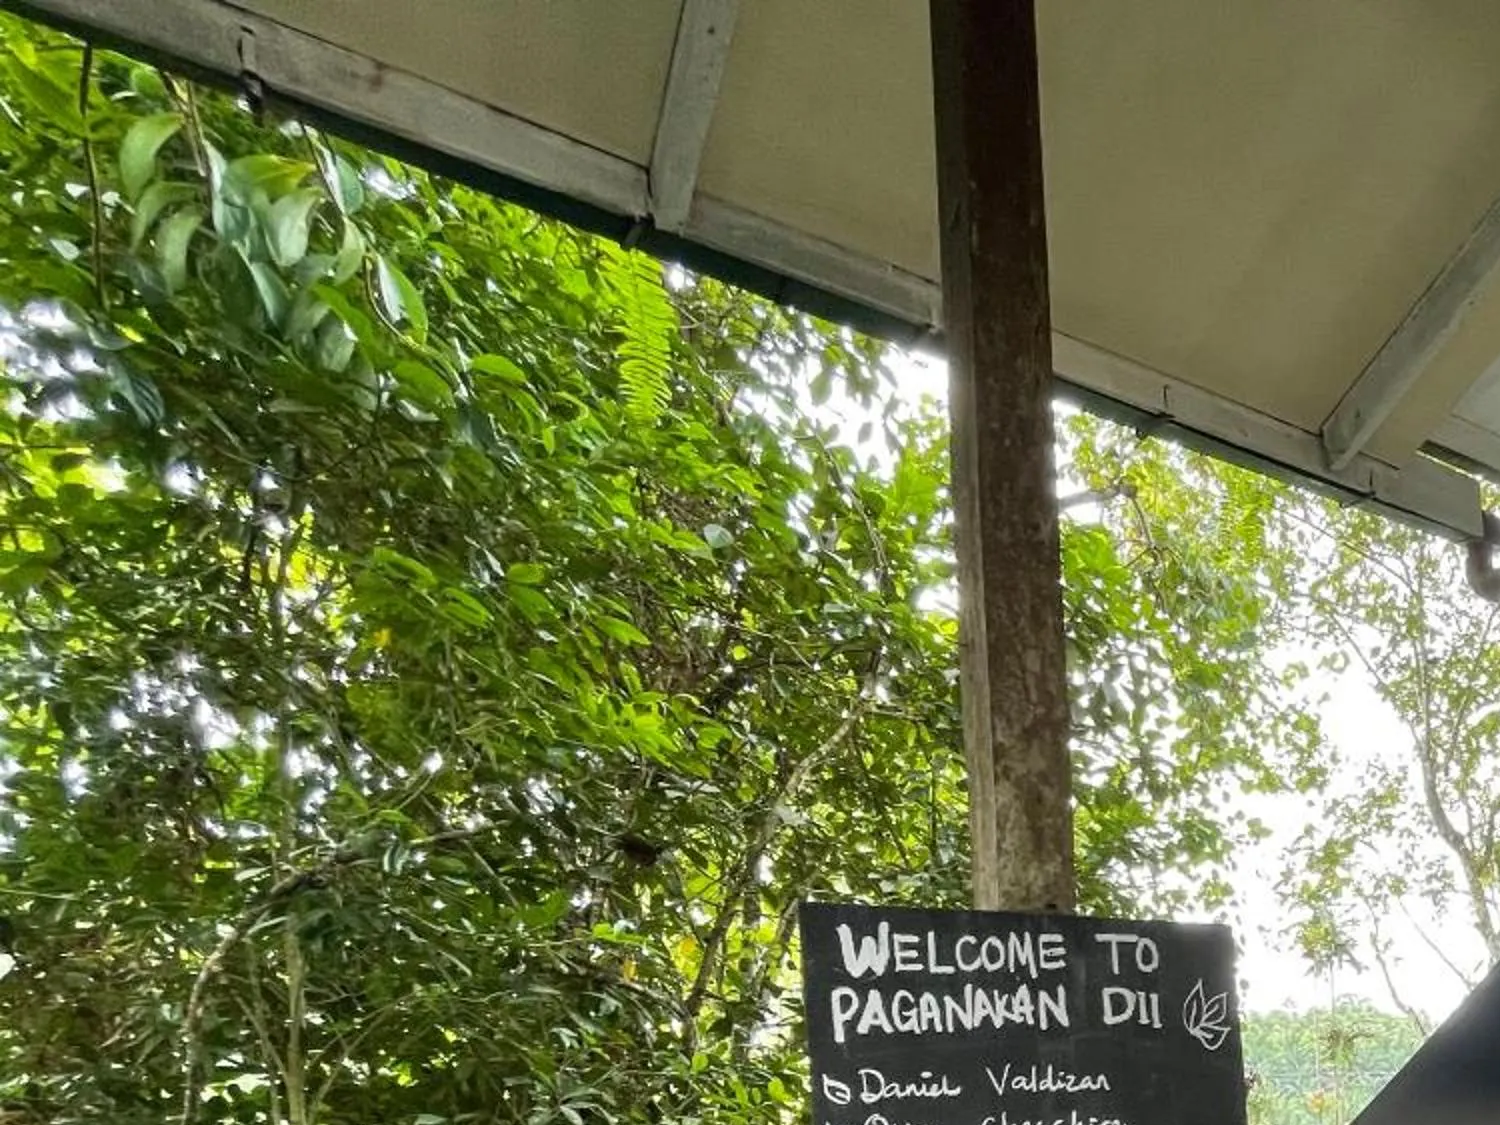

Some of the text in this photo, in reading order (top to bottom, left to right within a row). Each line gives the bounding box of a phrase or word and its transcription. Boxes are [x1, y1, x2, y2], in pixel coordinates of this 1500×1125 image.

[836, 921, 1159, 979] WELCOME TO
[831, 984, 1163, 1042] PAGANAKAN DII
[986, 1064, 1111, 1095] Valdizan
